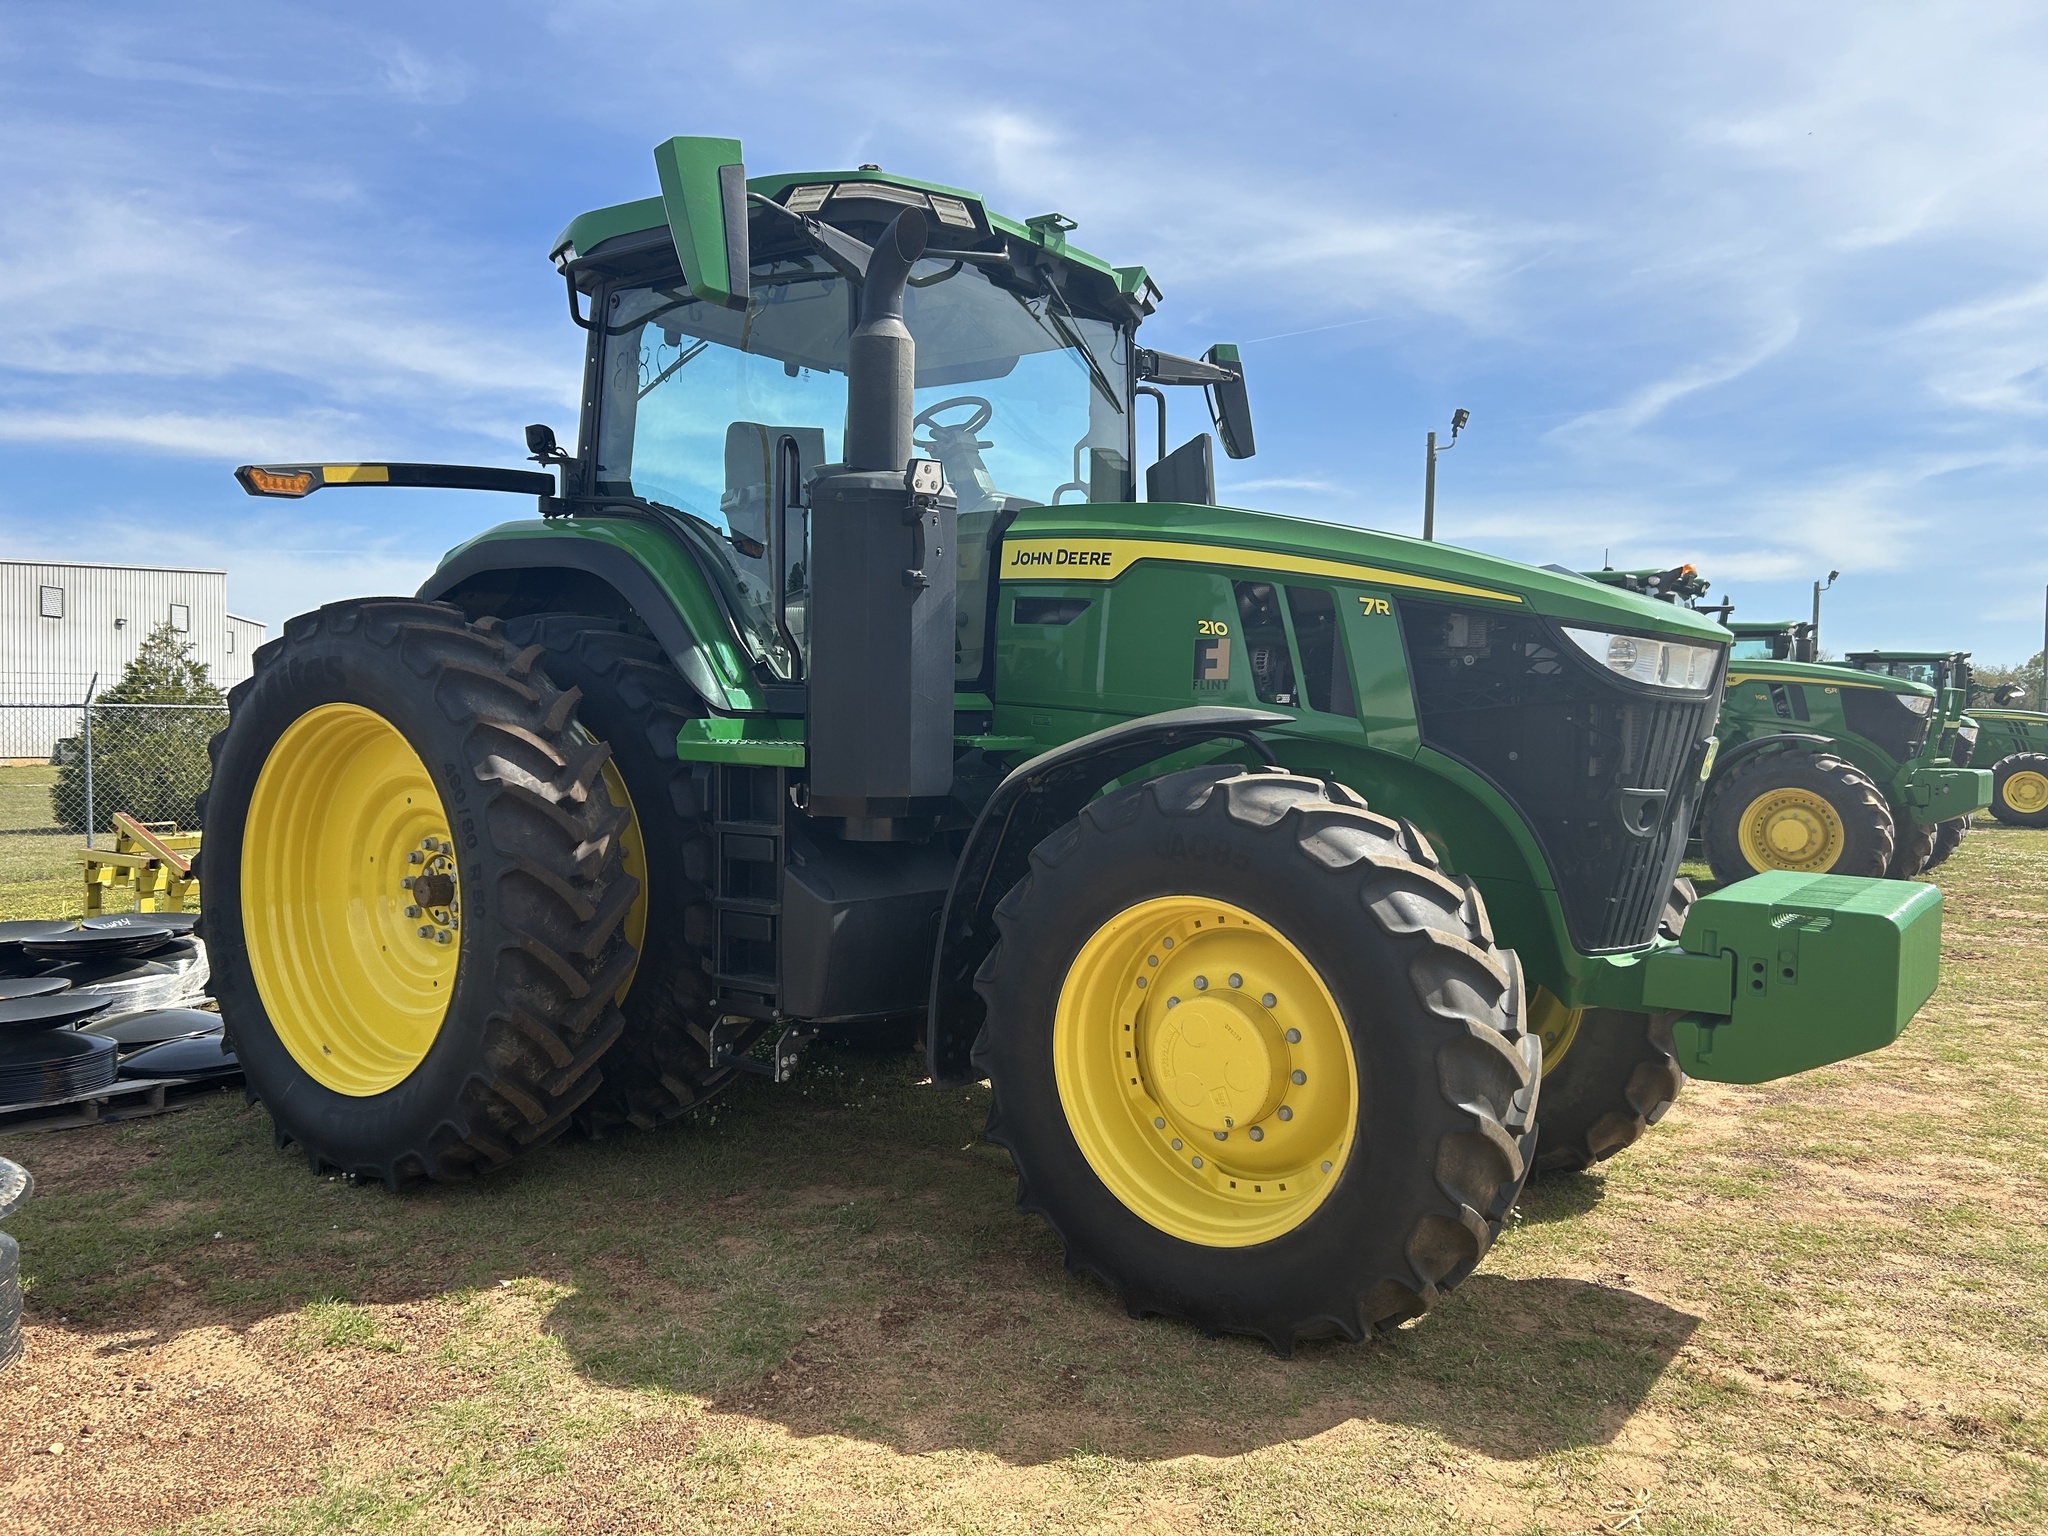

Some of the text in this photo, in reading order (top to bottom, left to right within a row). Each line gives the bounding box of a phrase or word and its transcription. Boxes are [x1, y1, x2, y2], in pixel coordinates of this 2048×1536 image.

[1011, 549, 1112, 566] JOHN DEERE
[1358, 596, 1391, 616] 7R
[1197, 619, 1229, 636] 210
[1193, 680, 1228, 690] FLINT
